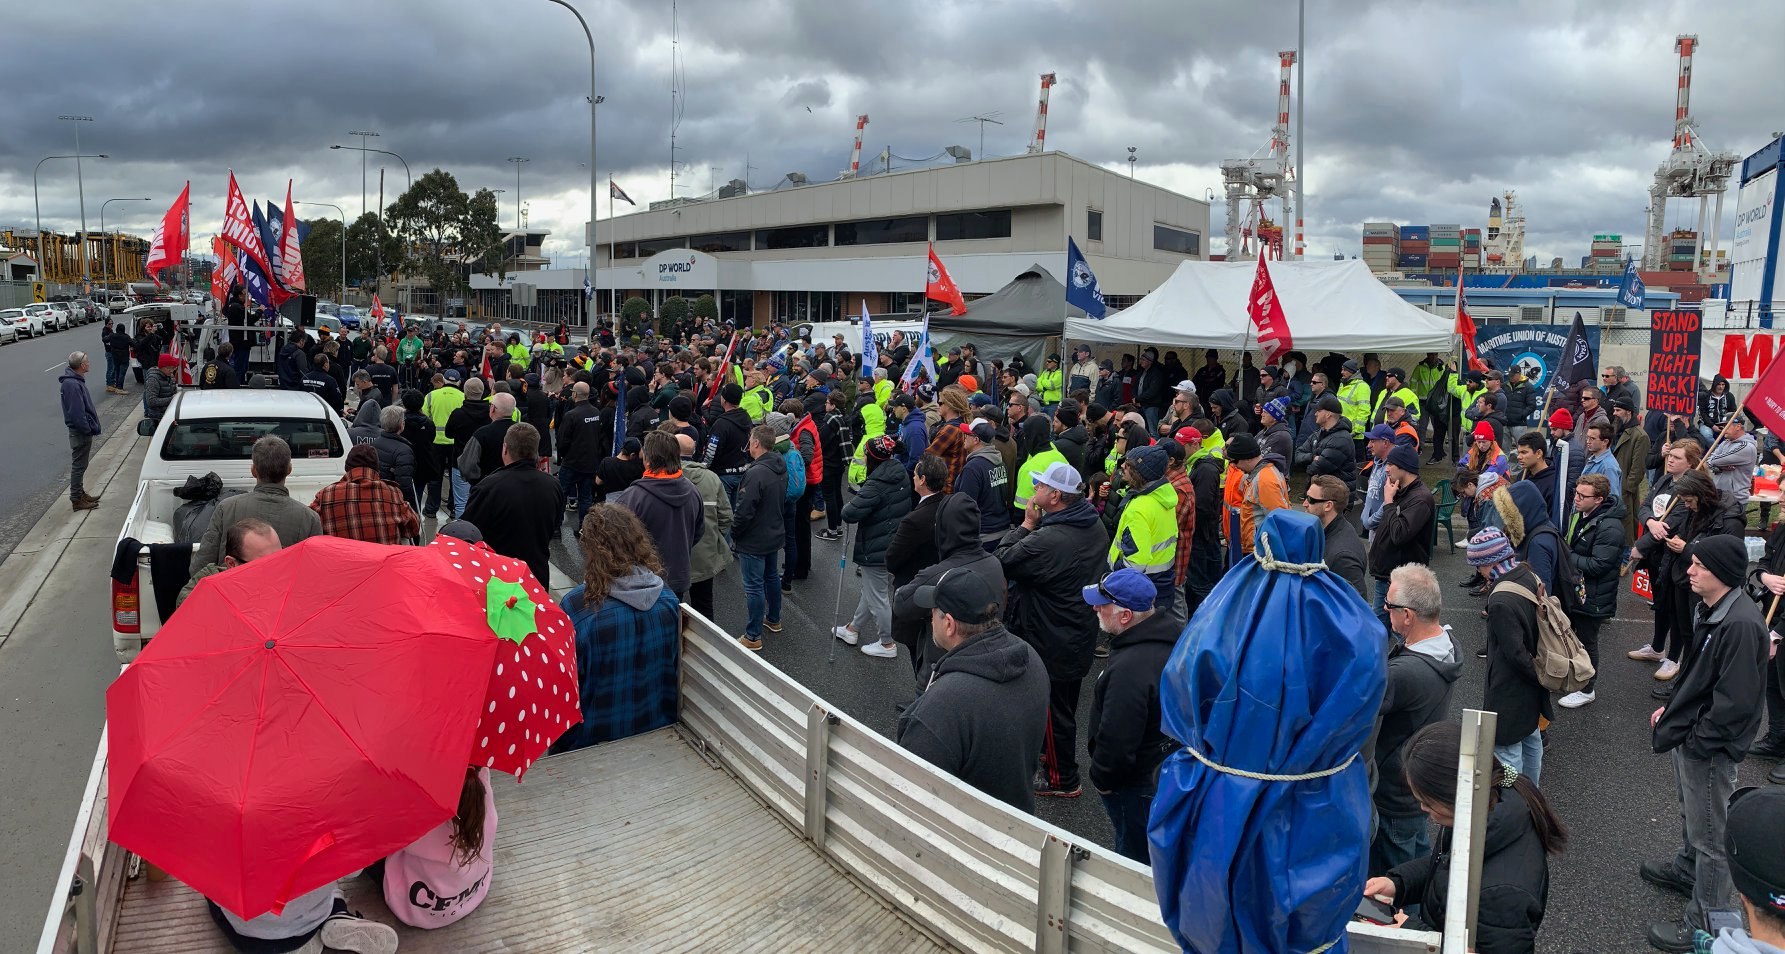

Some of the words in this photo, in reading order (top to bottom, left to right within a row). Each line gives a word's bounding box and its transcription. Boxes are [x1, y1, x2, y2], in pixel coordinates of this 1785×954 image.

[1746, 204, 1767, 224] WORLD
[658, 263, 667, 273] DP
[668, 262, 691, 273] WORLD
[659, 274, 677, 282] Australia
[1652, 311, 1699, 332] STAND
[1477, 332, 1512, 354] MARITIME
[1513, 330, 1535, 341] UNION
[1536, 331, 1546, 341] OF
[1662, 332, 1688, 354] UP!
[1650, 353, 1698, 374] FIGHT
[1648, 372, 1697, 397] BACK!
[1648, 393, 1695, 414] RAFFWU
